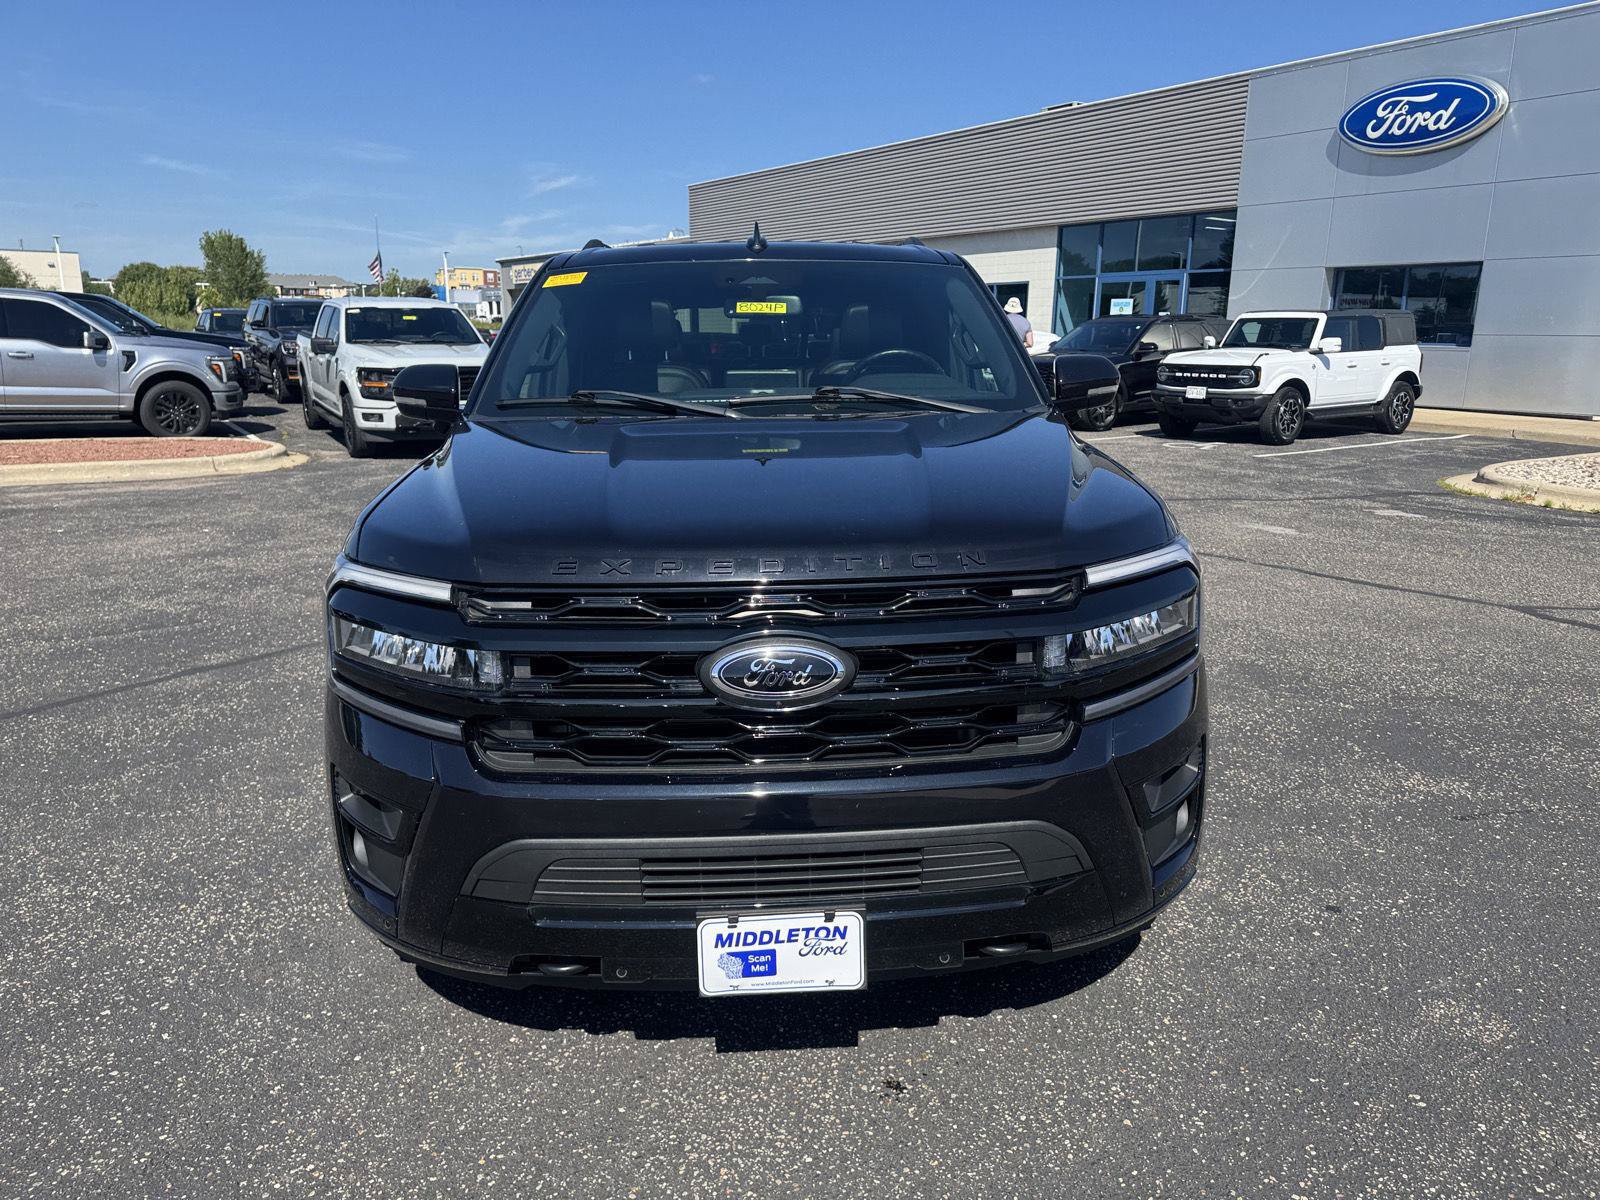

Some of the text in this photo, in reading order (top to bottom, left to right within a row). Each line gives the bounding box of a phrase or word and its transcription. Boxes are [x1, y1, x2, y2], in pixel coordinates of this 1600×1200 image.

[1366, 92, 1461, 139] Ford
[739, 302, 784, 312] 8024P
[551, 550, 987, 577] EXPEDITION
[743, 658, 812, 689] Ford
[714, 926, 848, 948] MIDDLETON
[798, 937, 848, 957] Ford
[748, 954, 771, 963] Scan
[751, 964, 769, 973] Me!
[750, 979, 814, 987] www.MiddletonFord.com
